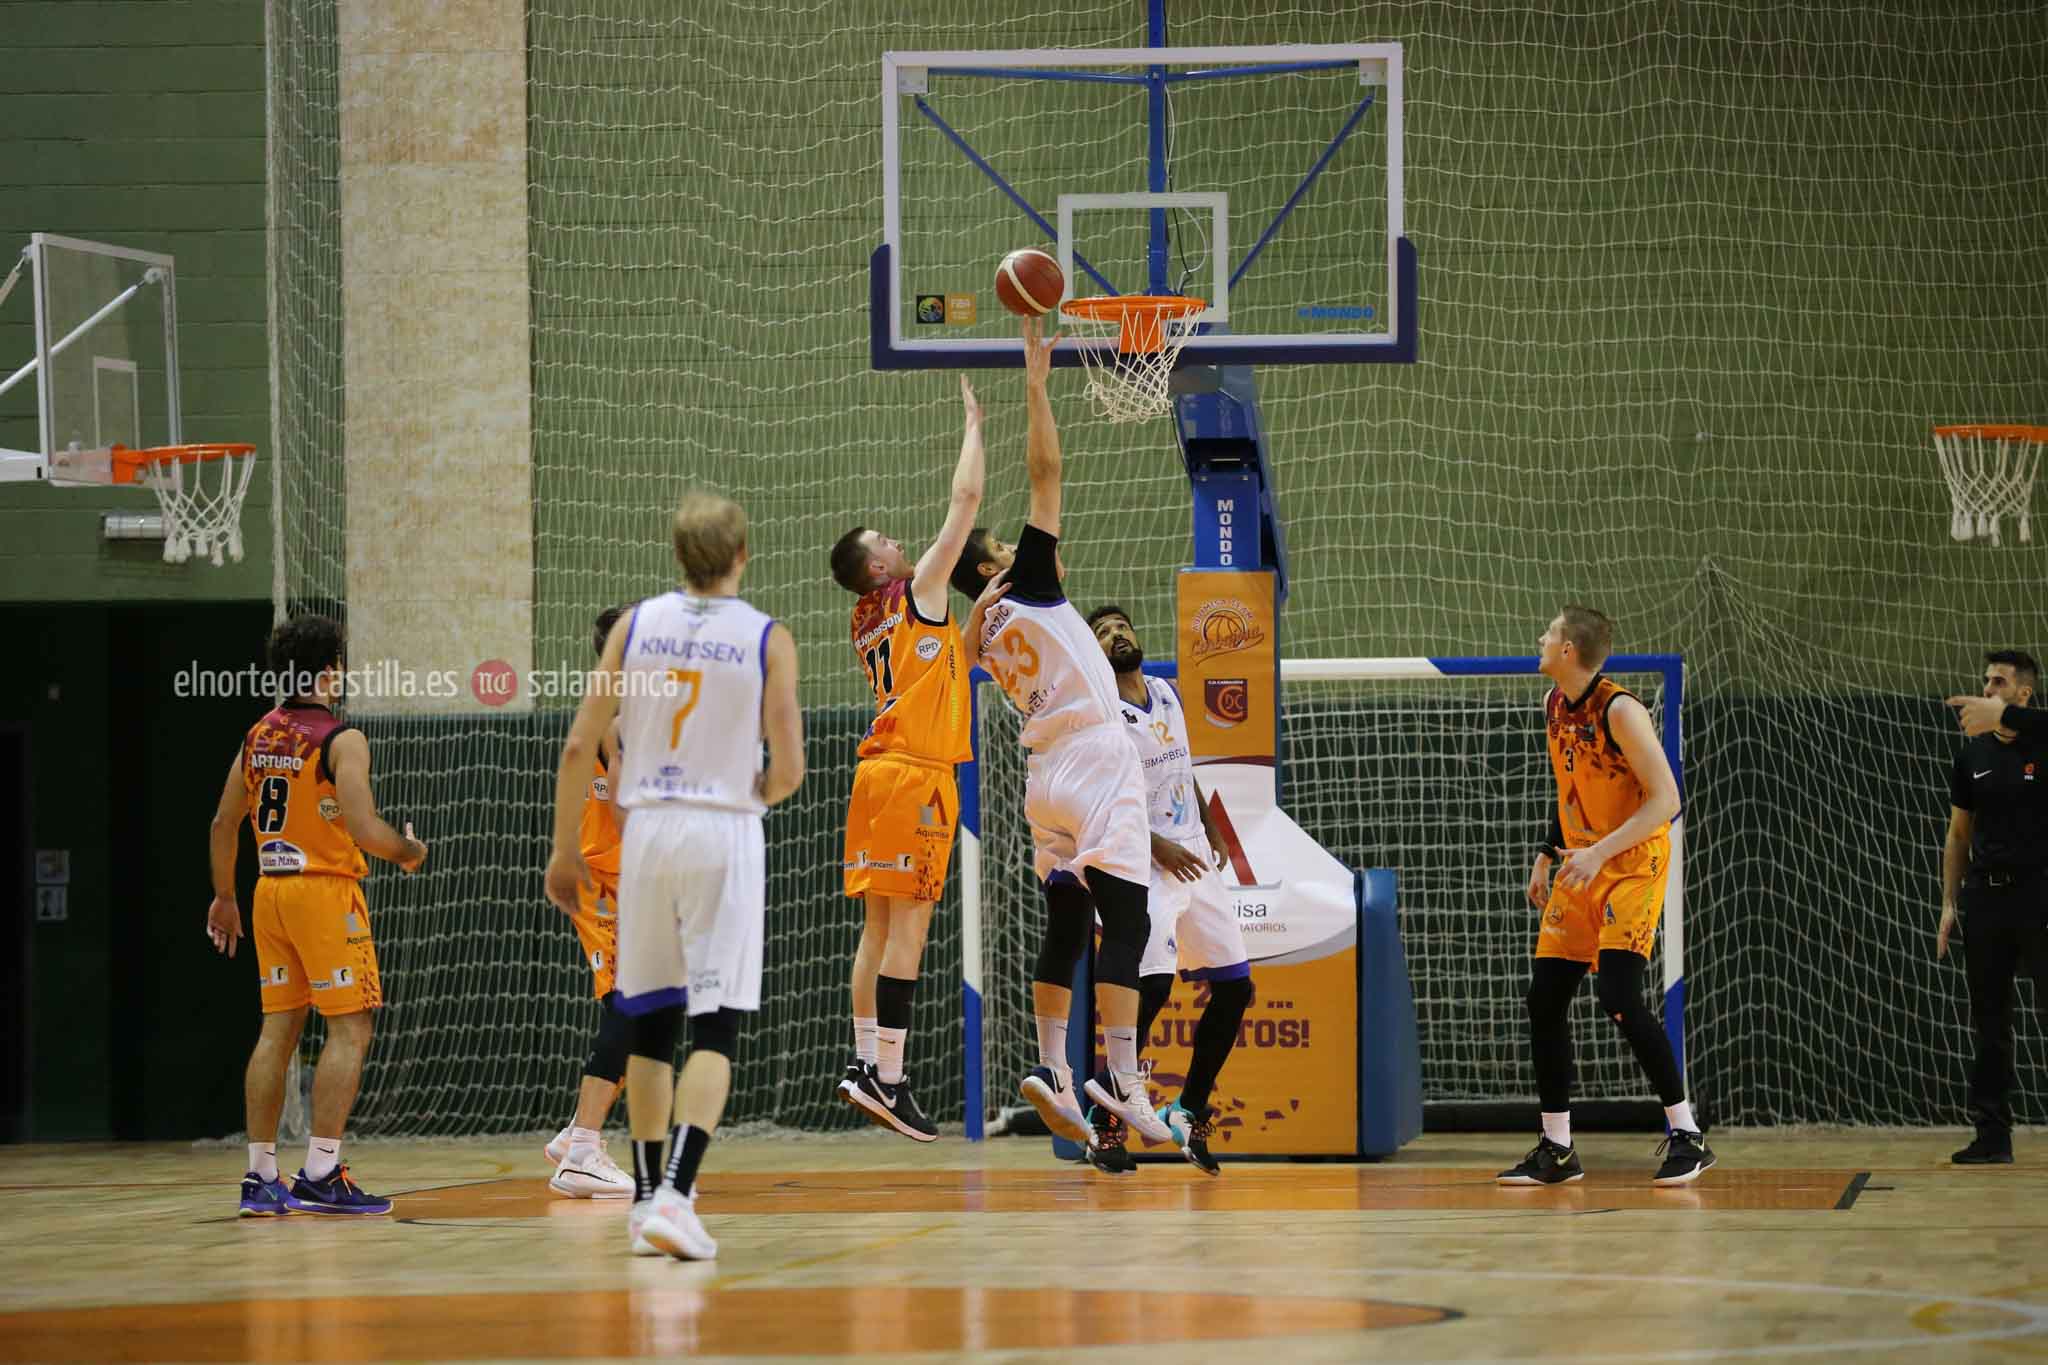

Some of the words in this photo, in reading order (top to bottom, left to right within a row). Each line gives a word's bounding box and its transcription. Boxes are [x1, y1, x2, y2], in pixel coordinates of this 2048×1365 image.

[1217, 499, 1234, 566] MONDO
[639, 638, 746, 665] KNUDSEN
[665, 667, 705, 753] 7
[250, 754, 305, 771] ARTURO
[258, 775, 291, 834] 8
